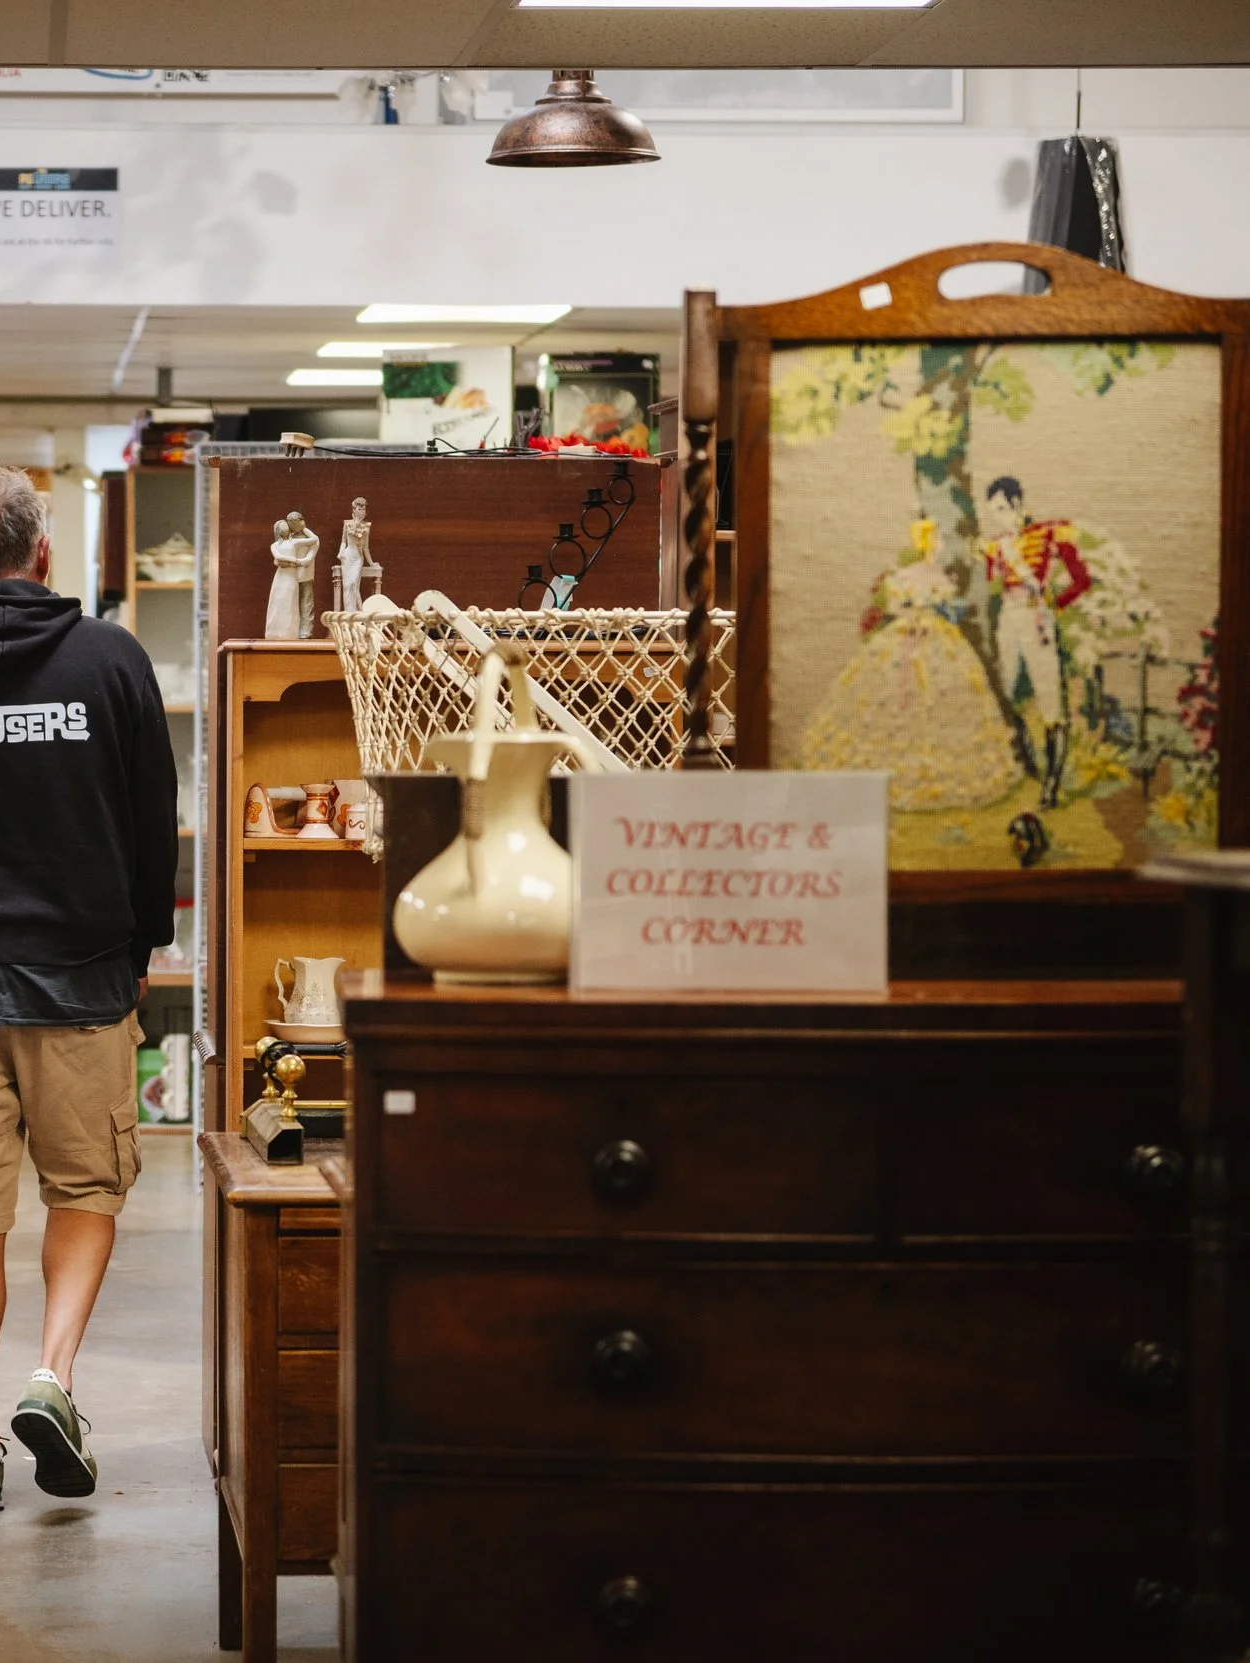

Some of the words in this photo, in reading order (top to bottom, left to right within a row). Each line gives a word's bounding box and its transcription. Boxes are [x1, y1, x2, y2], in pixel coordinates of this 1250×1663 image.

[21, 200, 111, 217] DELIVER.
[615, 816, 800, 853] VINTAGE
[807, 820, 835, 850] &
[605, 866, 843, 899] COLLECTORS
[640, 915, 808, 946] CORNER
